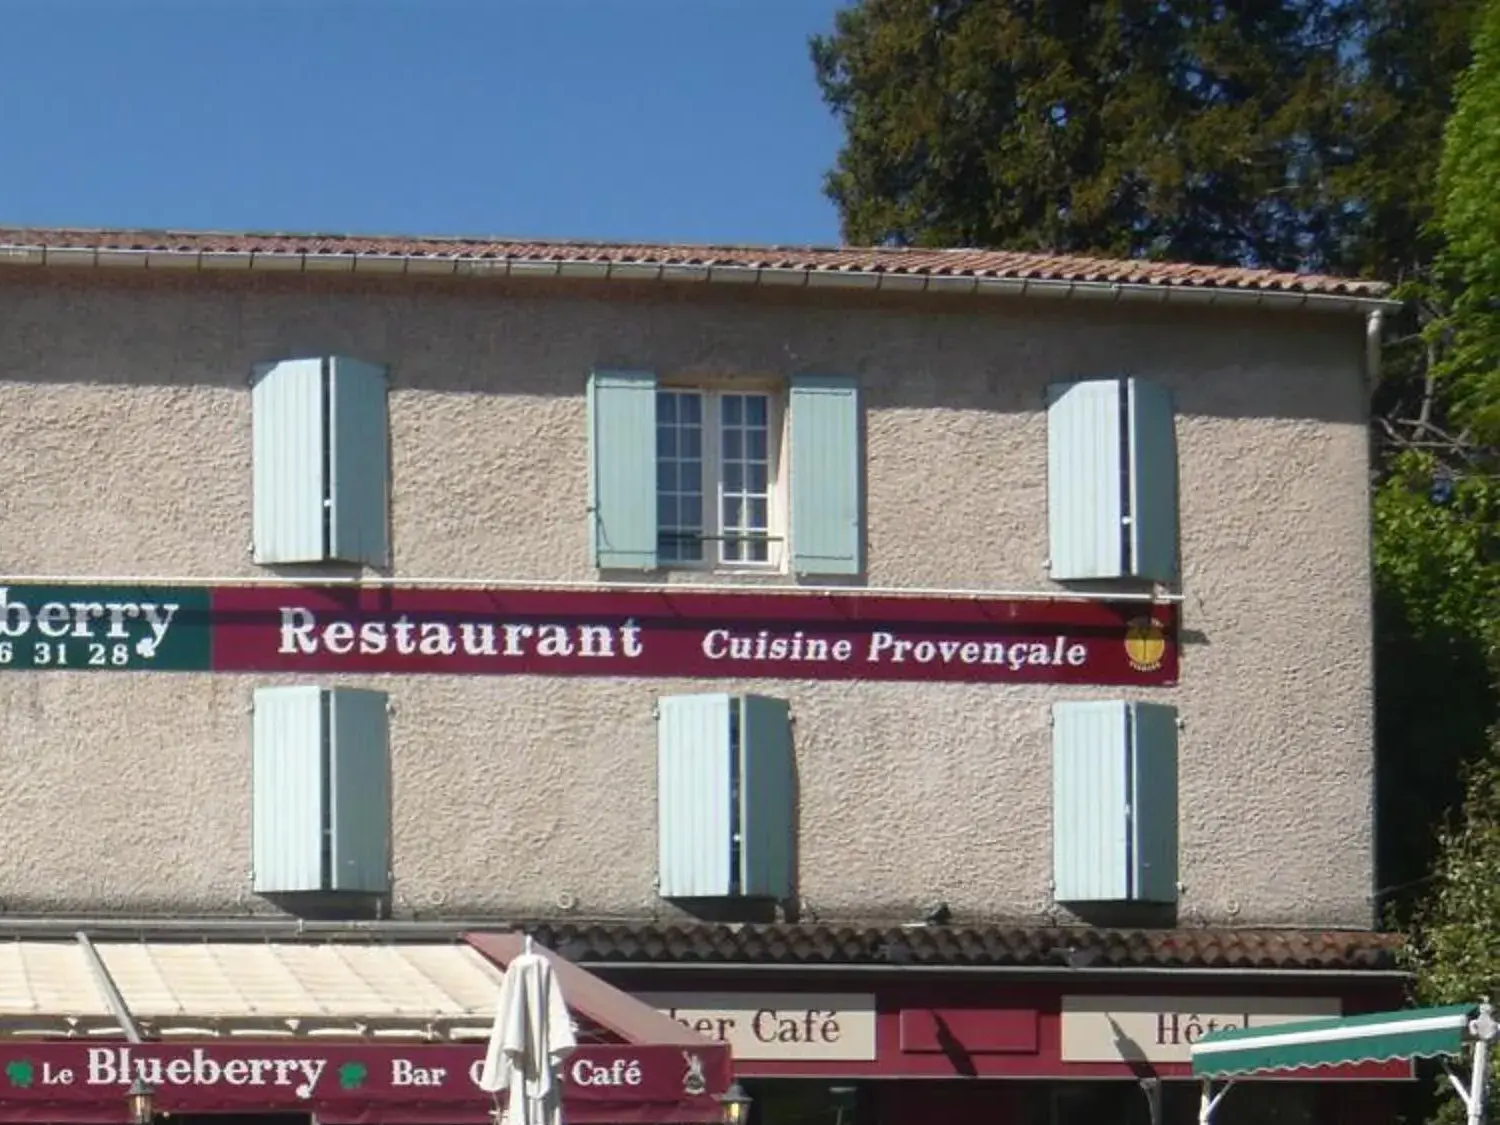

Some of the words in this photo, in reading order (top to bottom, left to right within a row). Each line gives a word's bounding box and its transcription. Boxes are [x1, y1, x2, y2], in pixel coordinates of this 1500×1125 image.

[277, 607, 643, 657] Restaurant
[702, 629, 851, 660] Cuisine
[867, 632, 1087, 670] Provençale
[34, 642, 67, 665] 31
[89, 642, 129, 665] 28
[752, 1008, 841, 1043] Café
[42, 1062, 73, 1085] Le
[87, 1047, 327, 1098] Blueberry
[392, 1059, 447, 1085] Bar
[572, 1059, 642, 1085] Café
